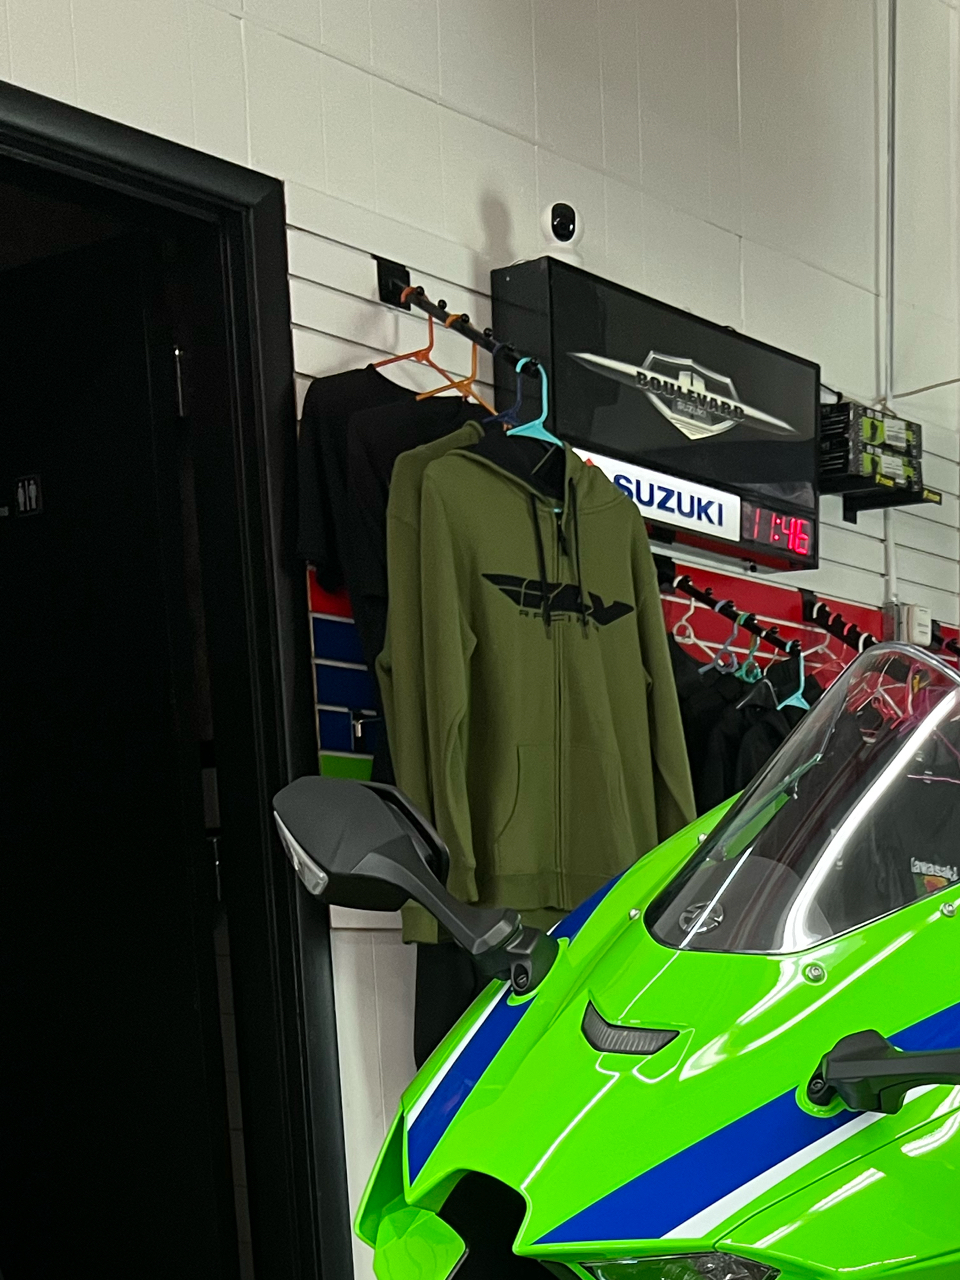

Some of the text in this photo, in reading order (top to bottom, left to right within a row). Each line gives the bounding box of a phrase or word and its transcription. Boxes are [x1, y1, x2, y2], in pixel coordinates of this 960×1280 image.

[635, 371, 745, 422] BOULEVARD
[613, 474, 723, 527] SUZUKI
[753, 508, 810, 556] 11:46
